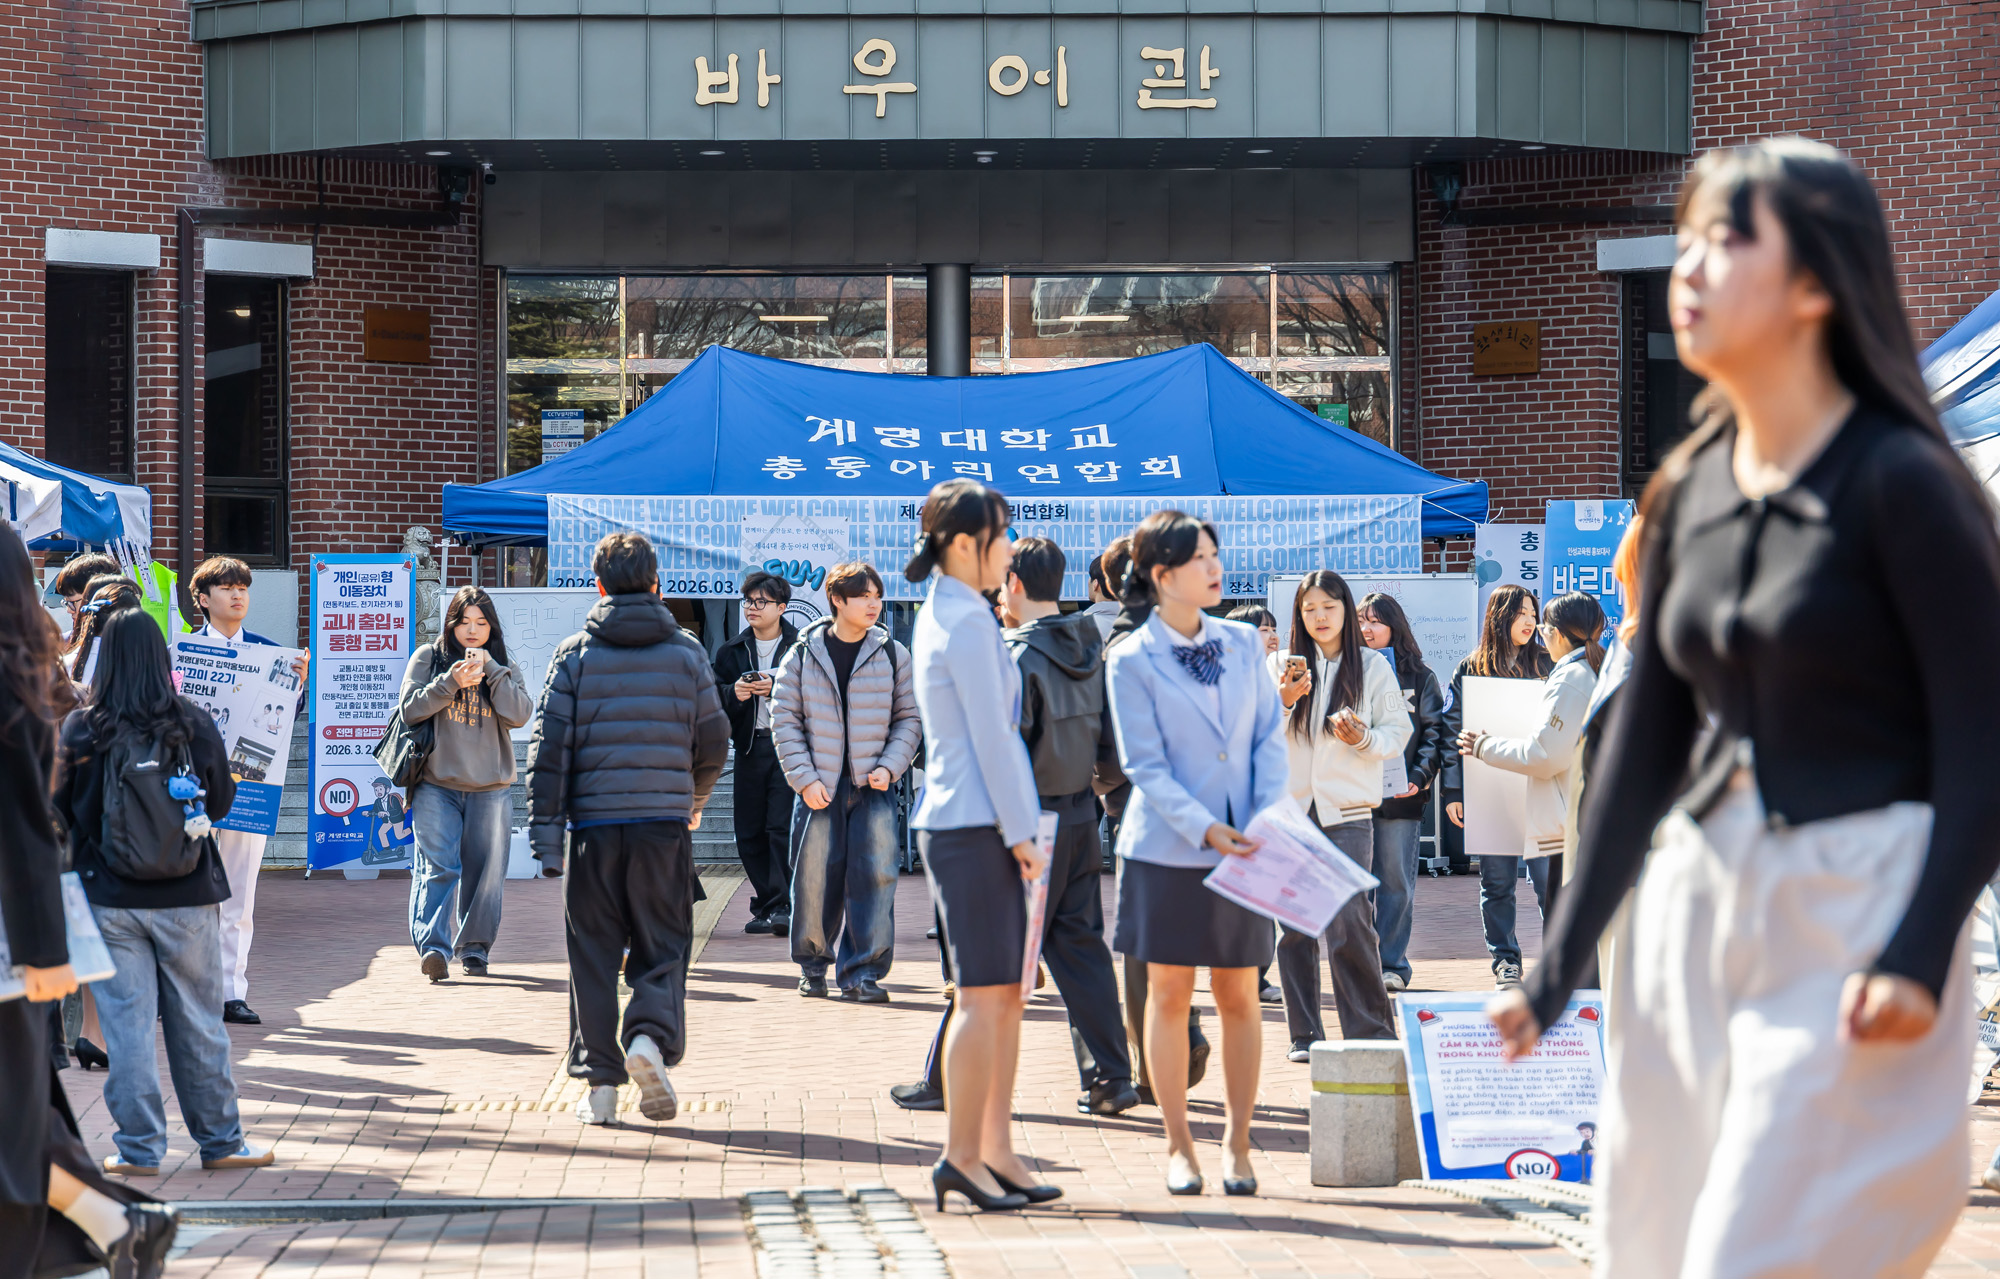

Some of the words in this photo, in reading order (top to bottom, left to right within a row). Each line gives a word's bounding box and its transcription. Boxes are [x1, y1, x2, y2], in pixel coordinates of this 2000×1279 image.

[805, 415, 1118, 452] 계명대학교
[761, 455, 1183, 484] 총동아리연합회
[649, 499, 757, 523] WELCOME
[1211, 499, 1320, 522] WELCOME
[1324, 497, 1419, 521] WELCOM
[1008, 503, 1069, 520] 리연합회
[649, 524, 742, 547] WELCOM
[1323, 521, 1418, 545] WELCOM
[780, 542, 809, 551] 총동아리
[811, 543, 835, 552] 연합회
[657, 547, 741, 570] WELCOM
[1323, 546, 1419, 570] WELCOM
[339, 585, 387, 597] 이동장치
[667, 579, 739, 594] 2026.03.
[1229, 581, 1256, 594] 장소
[360, 600, 393, 608] 전기자전거
[322, 614, 355, 631] 교내
[359, 613, 391, 631] 출입
[393, 617, 404, 630] 및
[513, 607, 560, 640] 탬프
[329, 634, 361, 651] 통행
[365, 634, 398, 651] 금지
[177, 655, 214, 668] 계명대학교
[210, 671, 236, 685] 22기
[180, 682, 217, 697] 집안내
[462, 691, 479, 703] ith
[449, 700, 492, 718] riginal
[336, 728, 353, 737] 전면
[325, 744, 353, 755] 2026.
[355, 744, 364, 755] 3.
[329, 790, 351, 804] NO!
[1437, 1051, 1474, 1059] TRONG
[1477, 1050, 1508, 1058] KHUÔ
[1516, 1162, 1551, 1175] NO!
